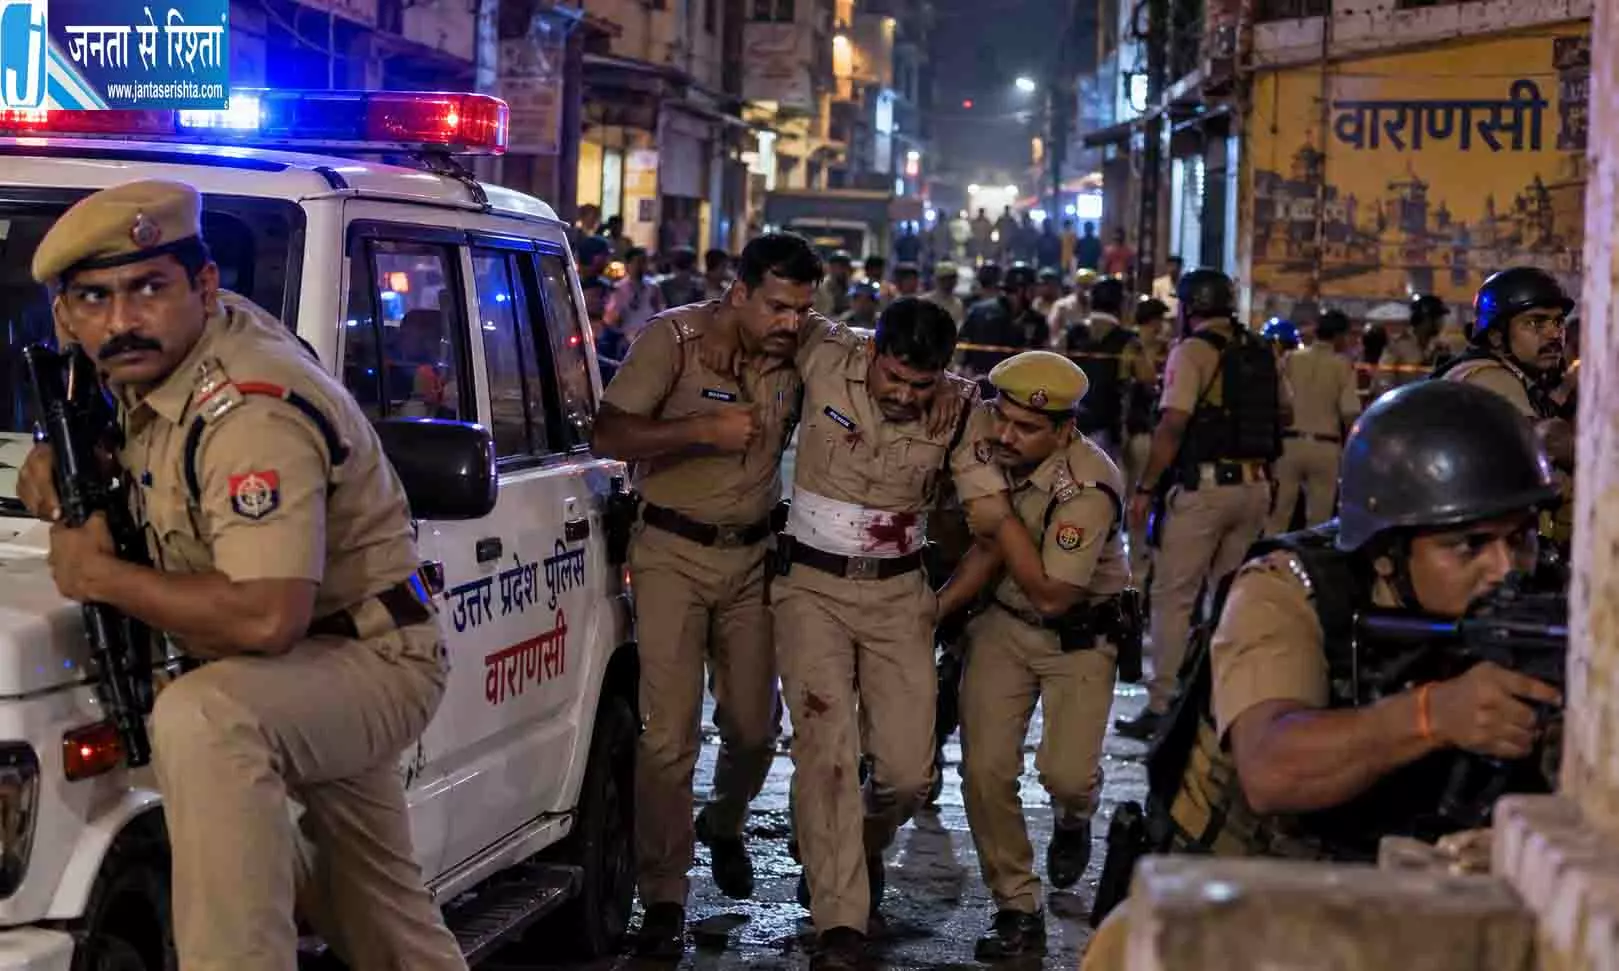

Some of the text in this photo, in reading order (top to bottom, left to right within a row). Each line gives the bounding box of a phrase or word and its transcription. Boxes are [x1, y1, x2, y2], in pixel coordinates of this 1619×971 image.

[1333, 79, 1548, 152] वाराणसी
[452, 539, 585, 632] उत्तर प्रदेश पुलिस
[485, 608, 567, 704] वाराणसी
